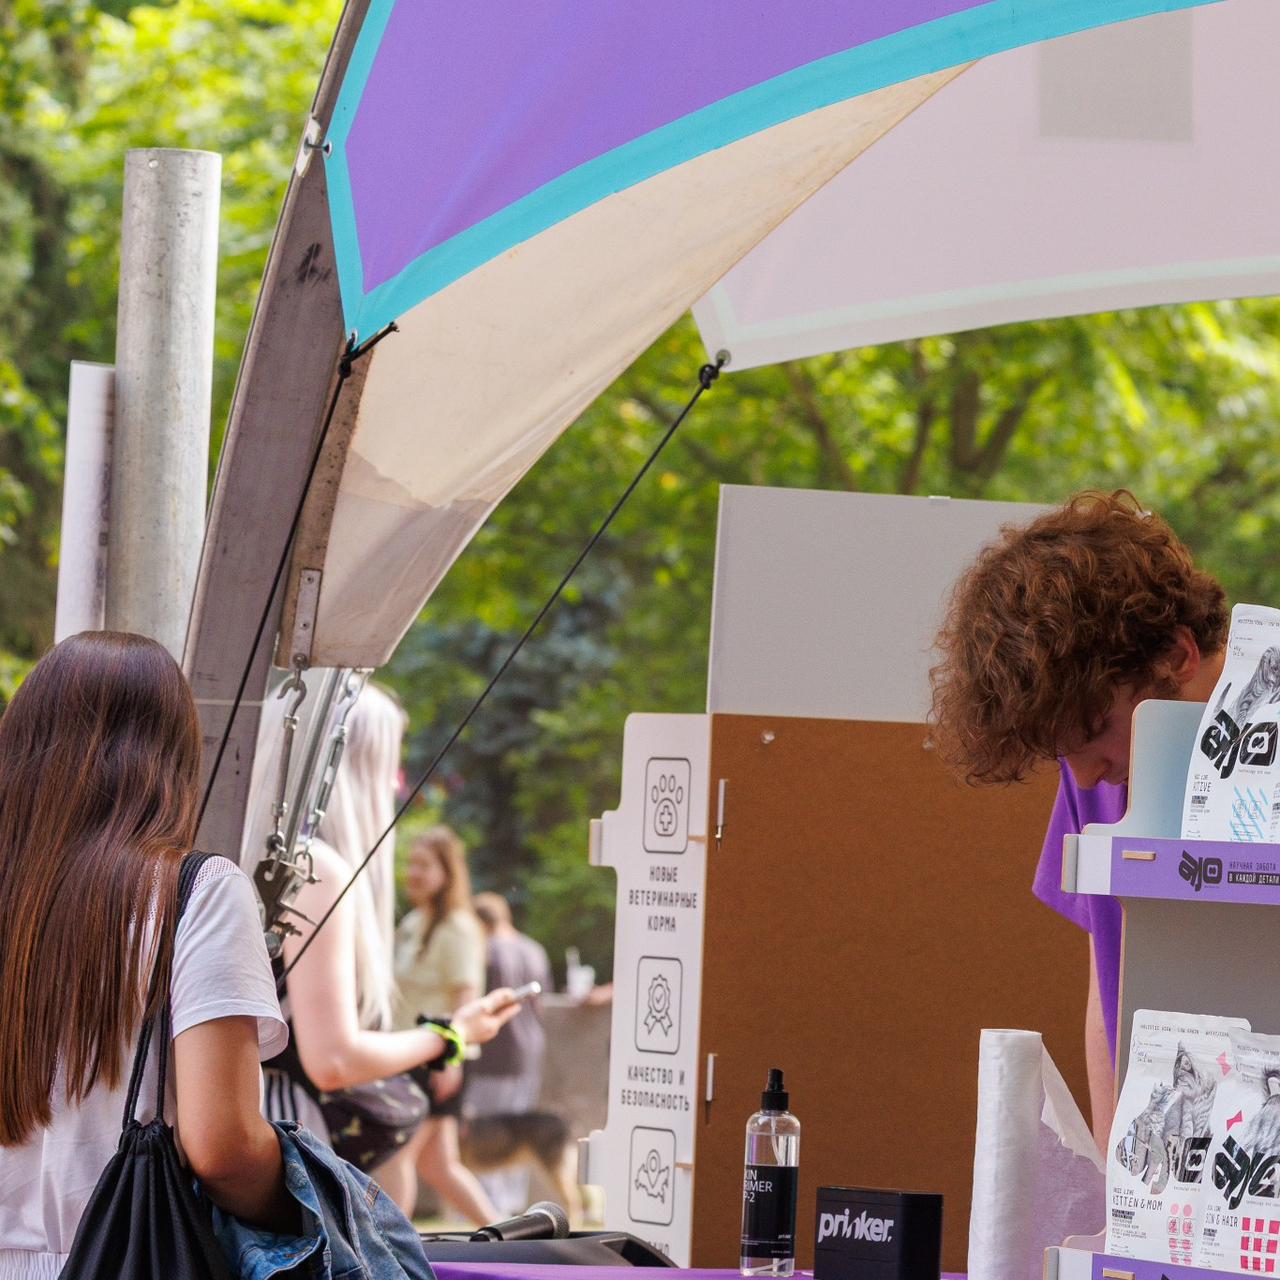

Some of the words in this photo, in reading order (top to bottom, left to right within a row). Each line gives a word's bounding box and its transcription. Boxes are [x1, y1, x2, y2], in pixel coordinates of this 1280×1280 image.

[650, 866, 678, 884] НОВЫЕ
[629, 889, 698, 910] ВЕТЕРИНАРНЫЕ
[647, 915, 676, 933] КОРМА
[627, 1065, 673, 1086] КАЧЕСТВО
[678, 1070, 686, 1086] И
[621, 1089, 690, 1112] БЕЗОПАСНОСТЬ
[1146, 1199, 1163, 1211] MOM
[1222, 1215, 1238, 1227] HAIR
